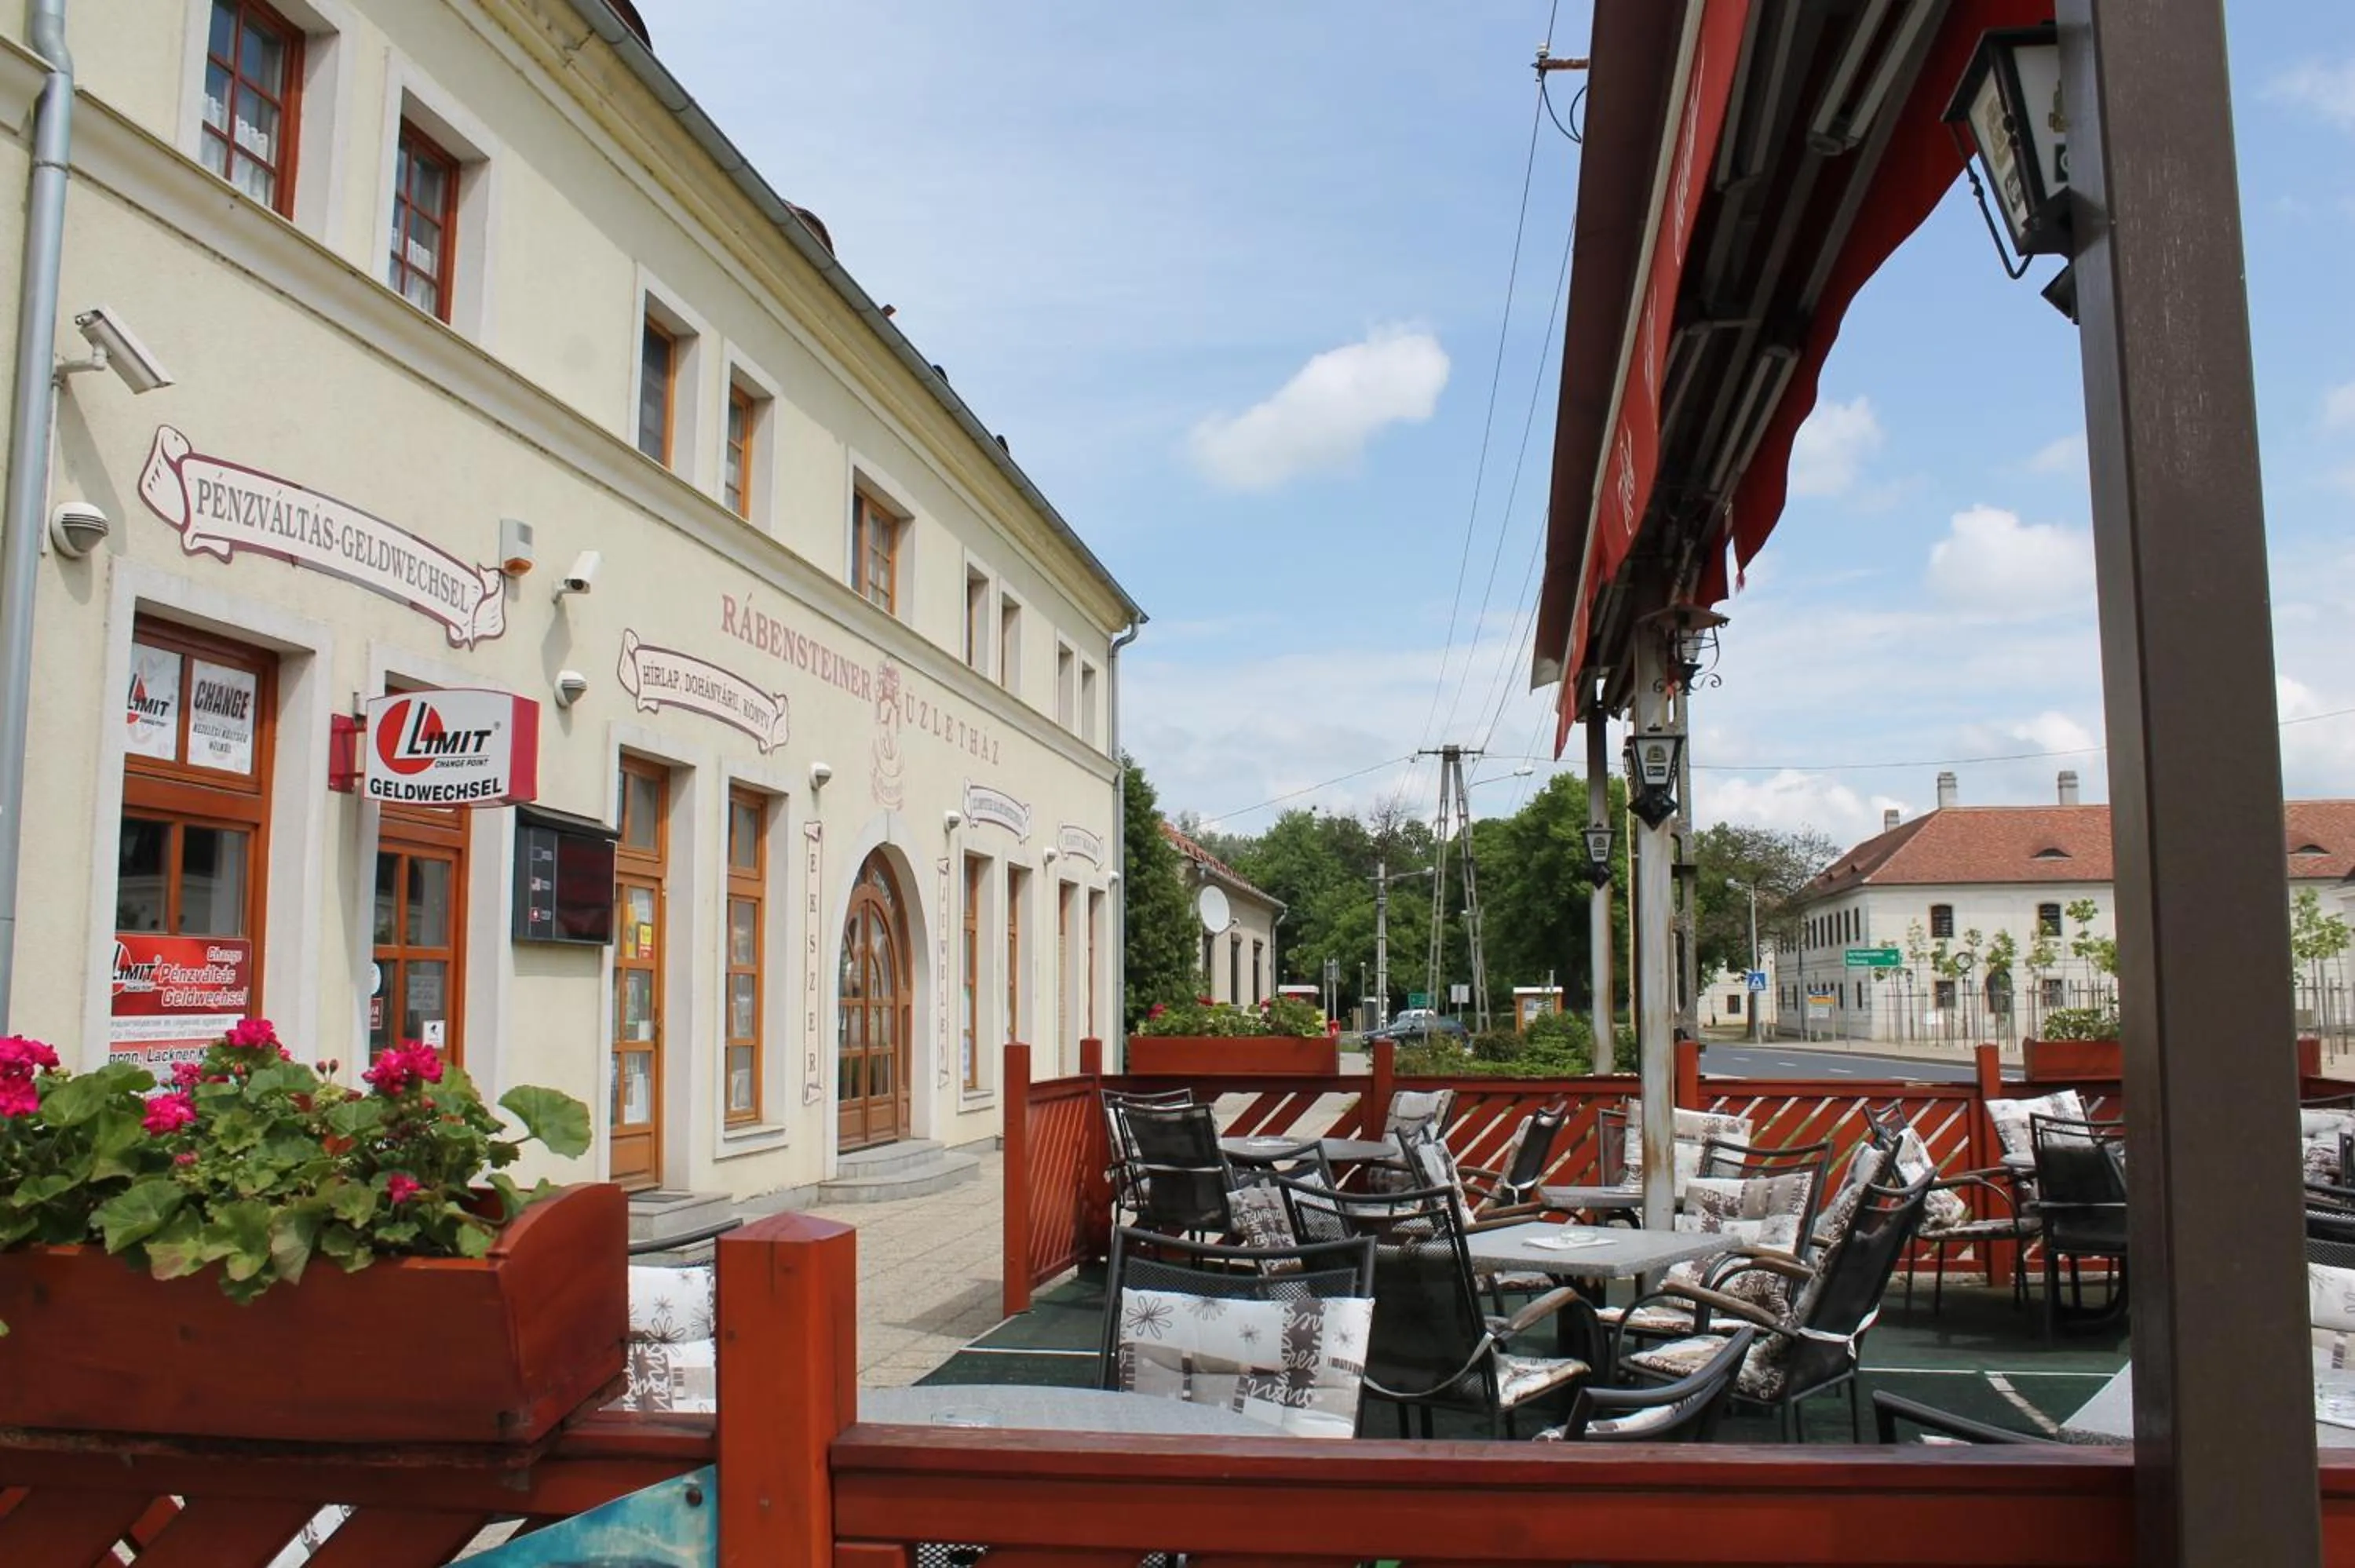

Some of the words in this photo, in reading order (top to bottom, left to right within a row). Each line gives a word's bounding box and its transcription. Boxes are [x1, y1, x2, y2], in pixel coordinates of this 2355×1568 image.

[195, 472, 469, 614] PÉNZVÁLTÁS-GELDWECHSEL
[721, 593, 872, 702] RÁBENSTEINER
[127, 673, 170, 716] LIMIT
[194, 680, 250, 720] CHANGE
[407, 702, 491, 755] LIMIT
[435, 759, 465, 768] CHANGE
[466, 758, 489, 767] POINT
[371, 778, 502, 800] GELDWECHSEL
[113, 943, 155, 981] LIMIT
[160, 965, 236, 983] Pénzváltás
[162, 987, 249, 1006] Geldwechsel
